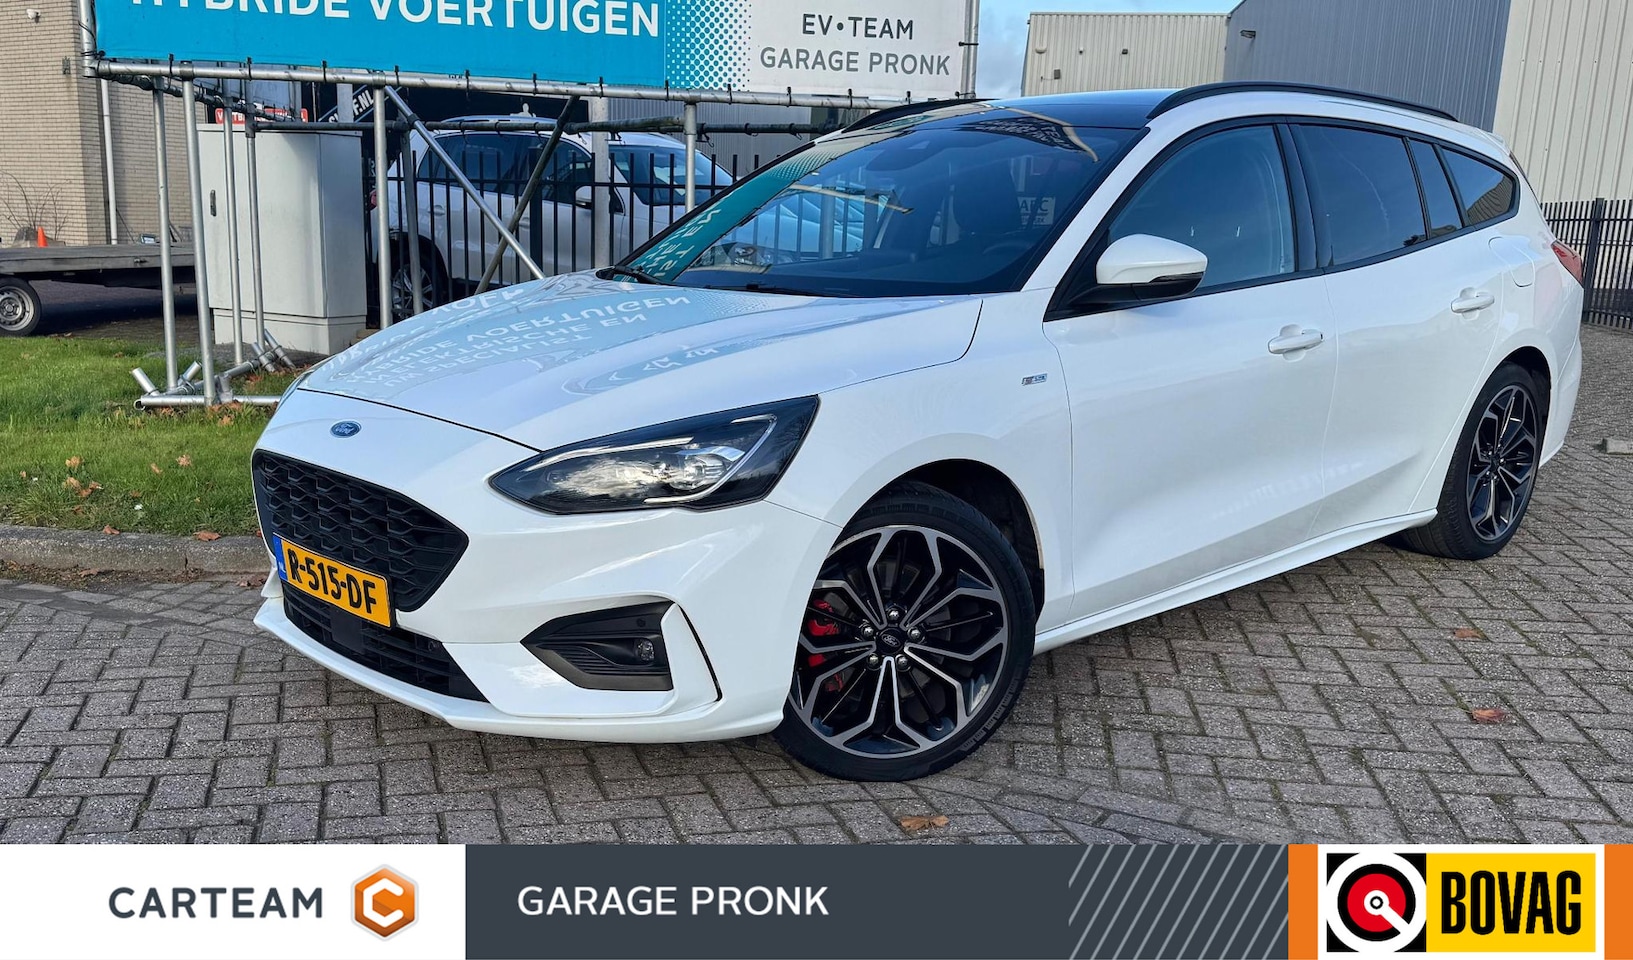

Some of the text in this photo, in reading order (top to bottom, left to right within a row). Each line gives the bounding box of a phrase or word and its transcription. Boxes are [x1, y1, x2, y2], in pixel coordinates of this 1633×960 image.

[369, 0, 659, 37] VOERTUIGEN
[760, 46, 951, 76] GARAGE PRONK
[287, 548, 377, 614] R-515-DF
